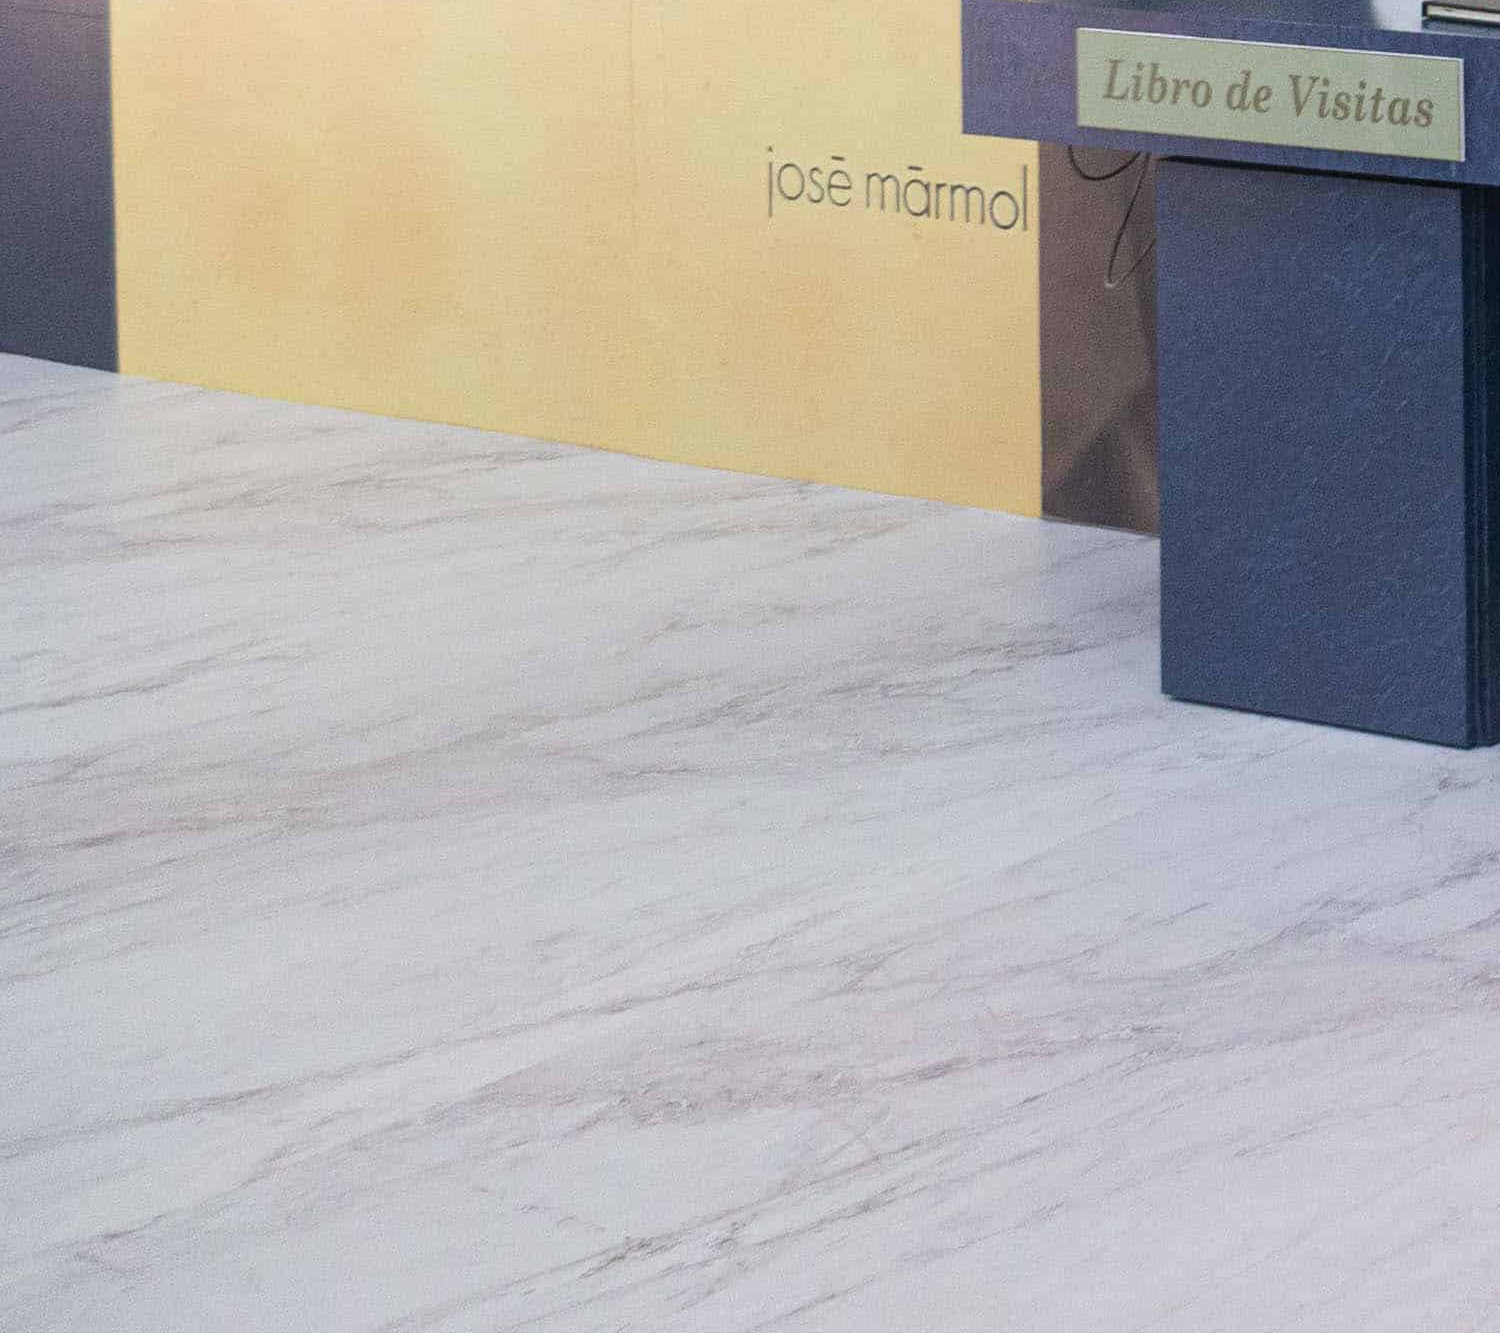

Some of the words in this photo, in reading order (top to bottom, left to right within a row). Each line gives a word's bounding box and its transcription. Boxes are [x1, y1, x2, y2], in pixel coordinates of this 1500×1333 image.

[1101, 57, 1213, 110] Libro
[1225, 68, 1273, 115] de
[1288, 73, 1435, 129] Visitas
